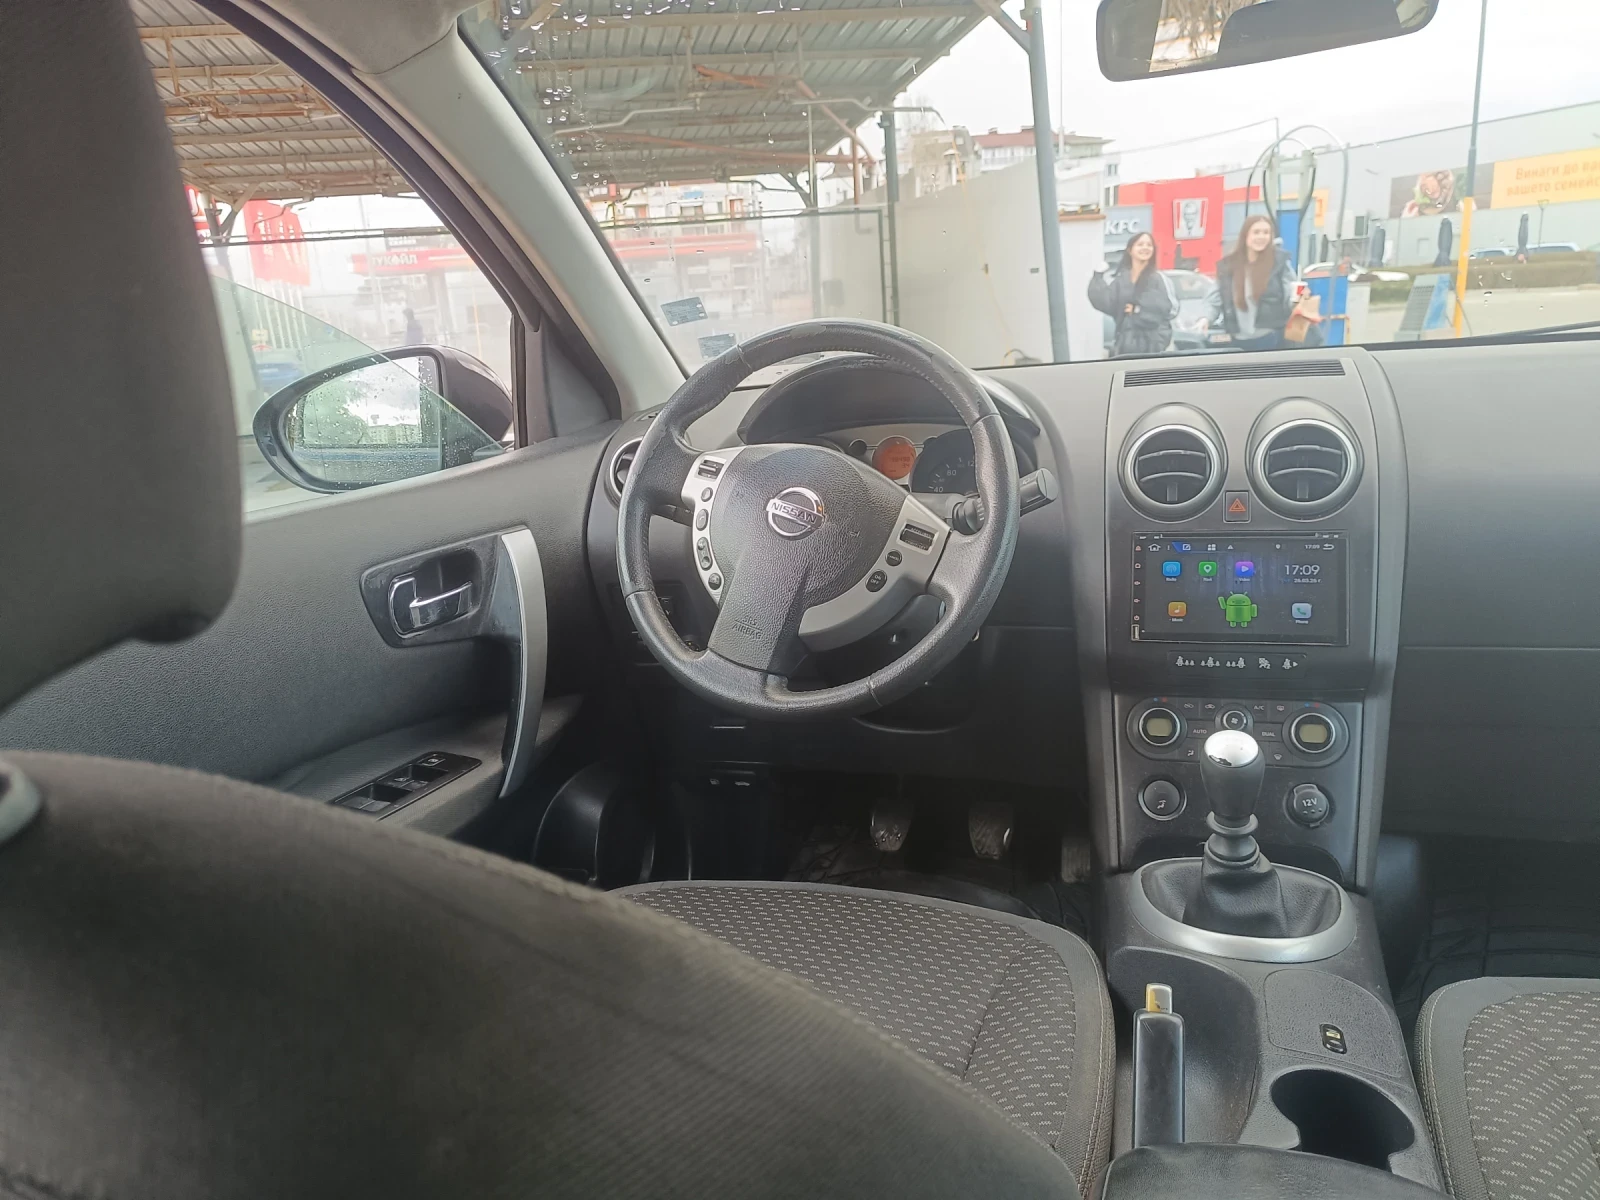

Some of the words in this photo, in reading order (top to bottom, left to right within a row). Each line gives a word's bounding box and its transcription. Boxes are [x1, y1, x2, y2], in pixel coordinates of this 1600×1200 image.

[1515, 166, 1559, 180] Винаги
[1562, 163, 1578, 176] до
[1582, 160, 1600, 172] ва
[1507, 182, 1551, 196] вашето
[1105, 218, 1140, 235] KFC
[771, 502, 818, 523] NISSAN
[1284, 565, 1320, 576] 17:09
[1302, 797, 1317, 807] 12V
